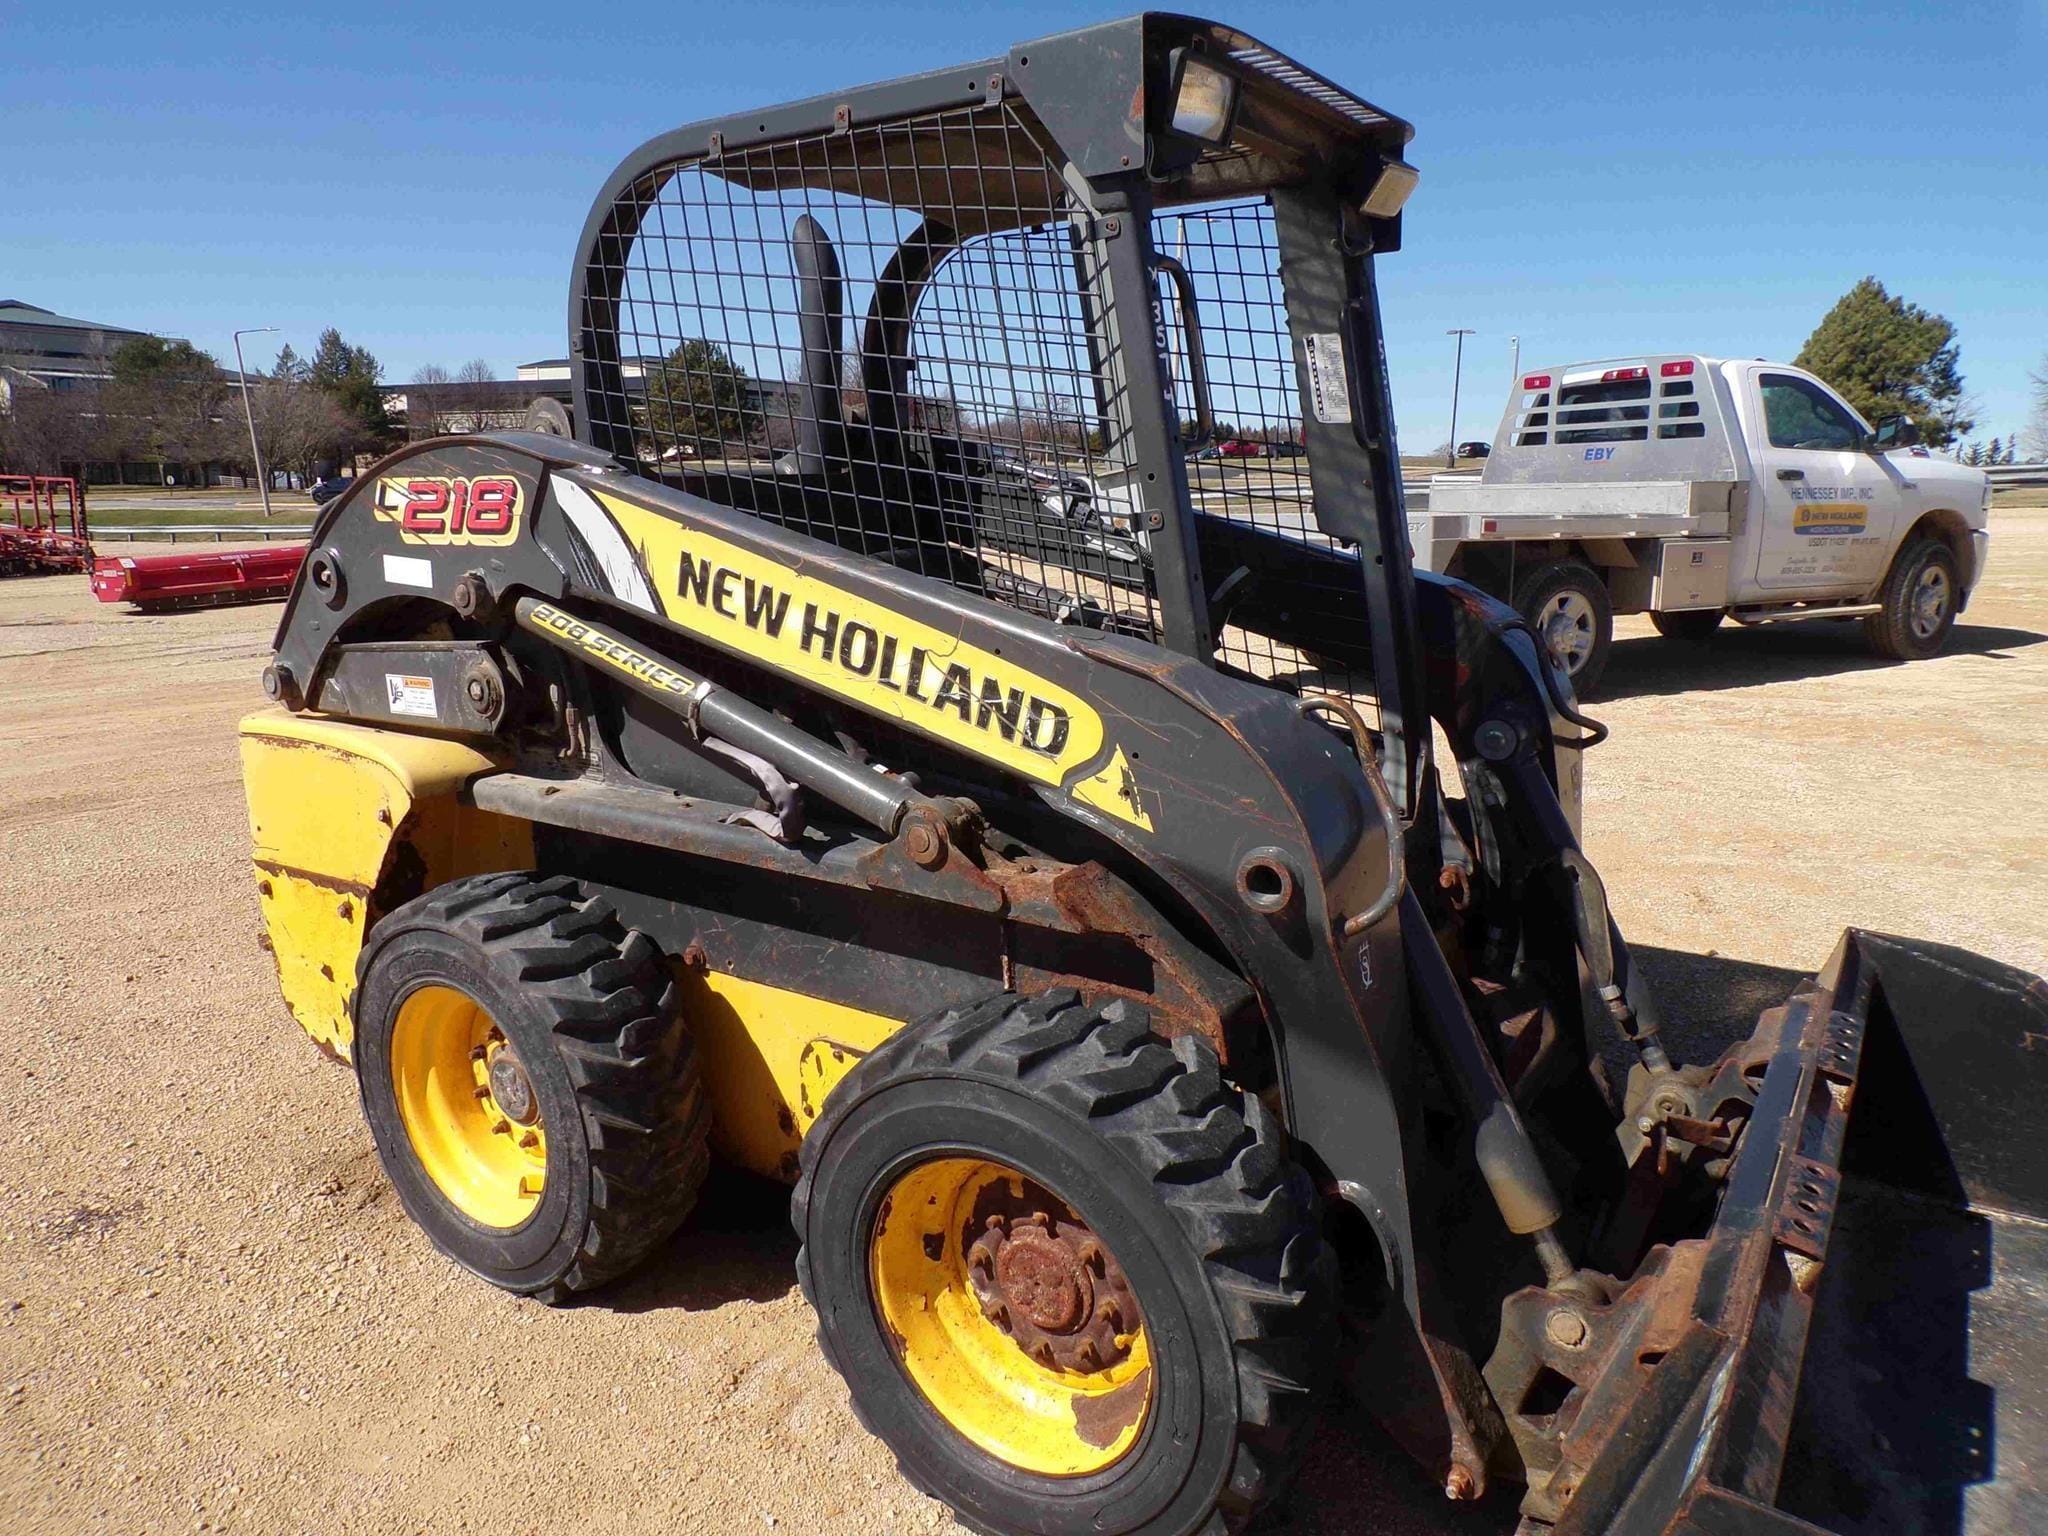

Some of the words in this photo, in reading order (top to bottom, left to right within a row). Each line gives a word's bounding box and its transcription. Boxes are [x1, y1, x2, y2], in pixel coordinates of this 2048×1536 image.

[1584, 447, 1616, 461] EBY
[376, 478, 517, 536] L218
[1791, 487, 1838, 500] HENNESSEY
[1811, 512, 1829, 520] NEW
[1829, 511, 1863, 520] HOLLAND
[590, 636, 692, 693] SERIES
[676, 550, 792, 640] NEW
[799, 602, 1070, 758] HOLLAND
